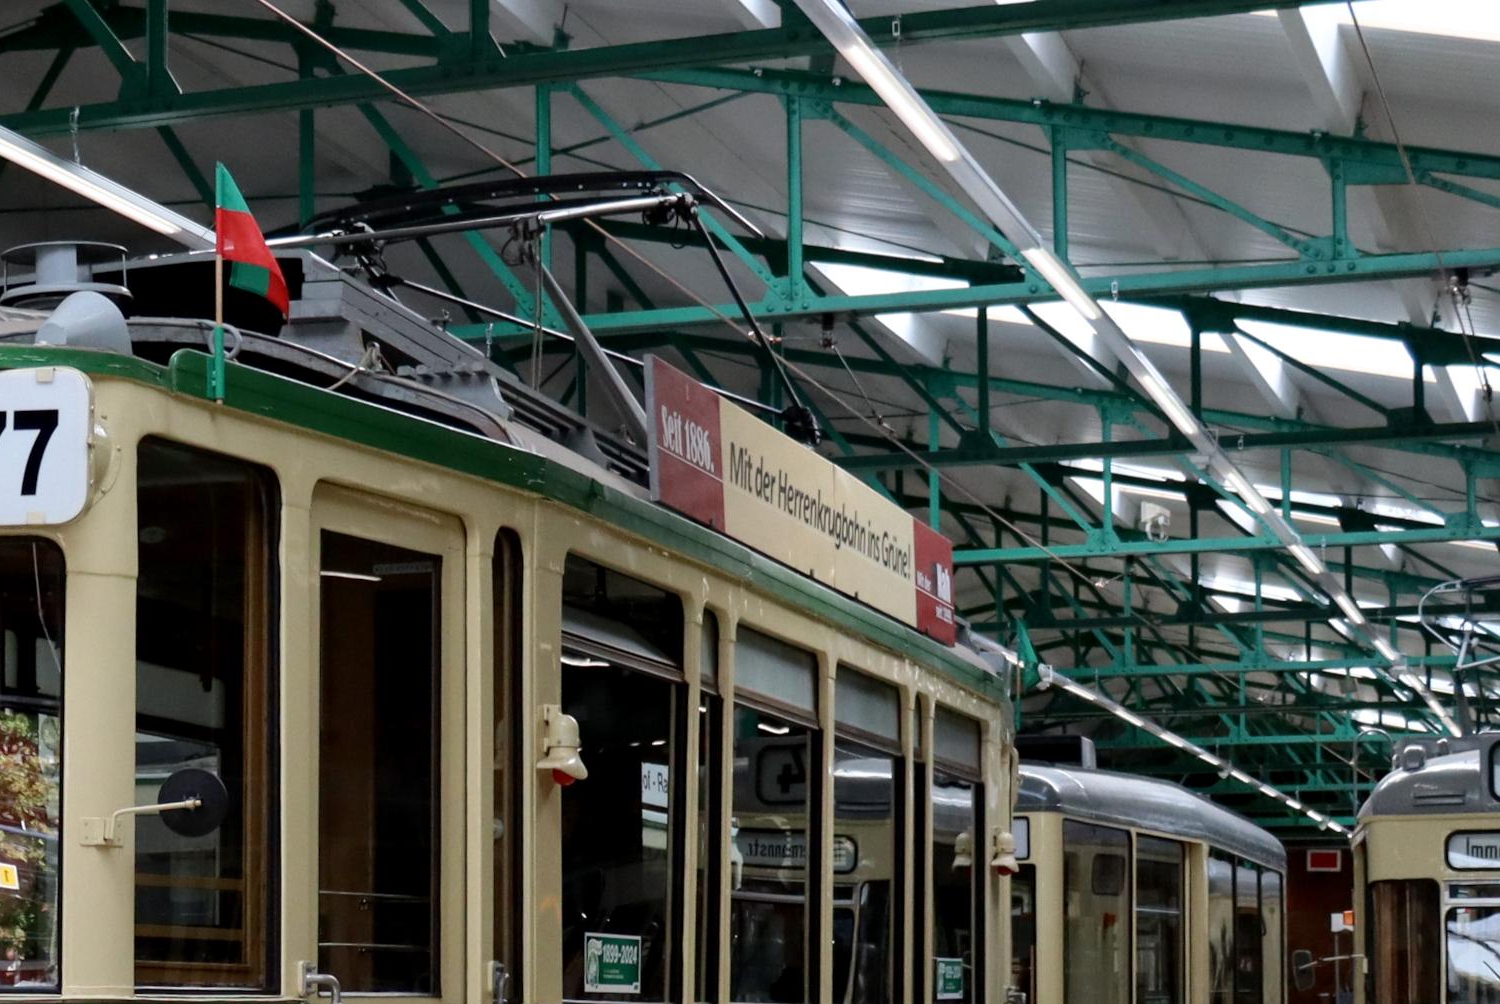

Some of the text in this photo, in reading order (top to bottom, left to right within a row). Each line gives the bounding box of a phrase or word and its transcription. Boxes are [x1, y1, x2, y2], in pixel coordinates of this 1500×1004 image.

[661, 404, 683, 457] Seit
[729, 441, 911, 579] Mit der Herrenkrugbahn ins Grüne!
[1466, 836, 1500, 859] Imm
